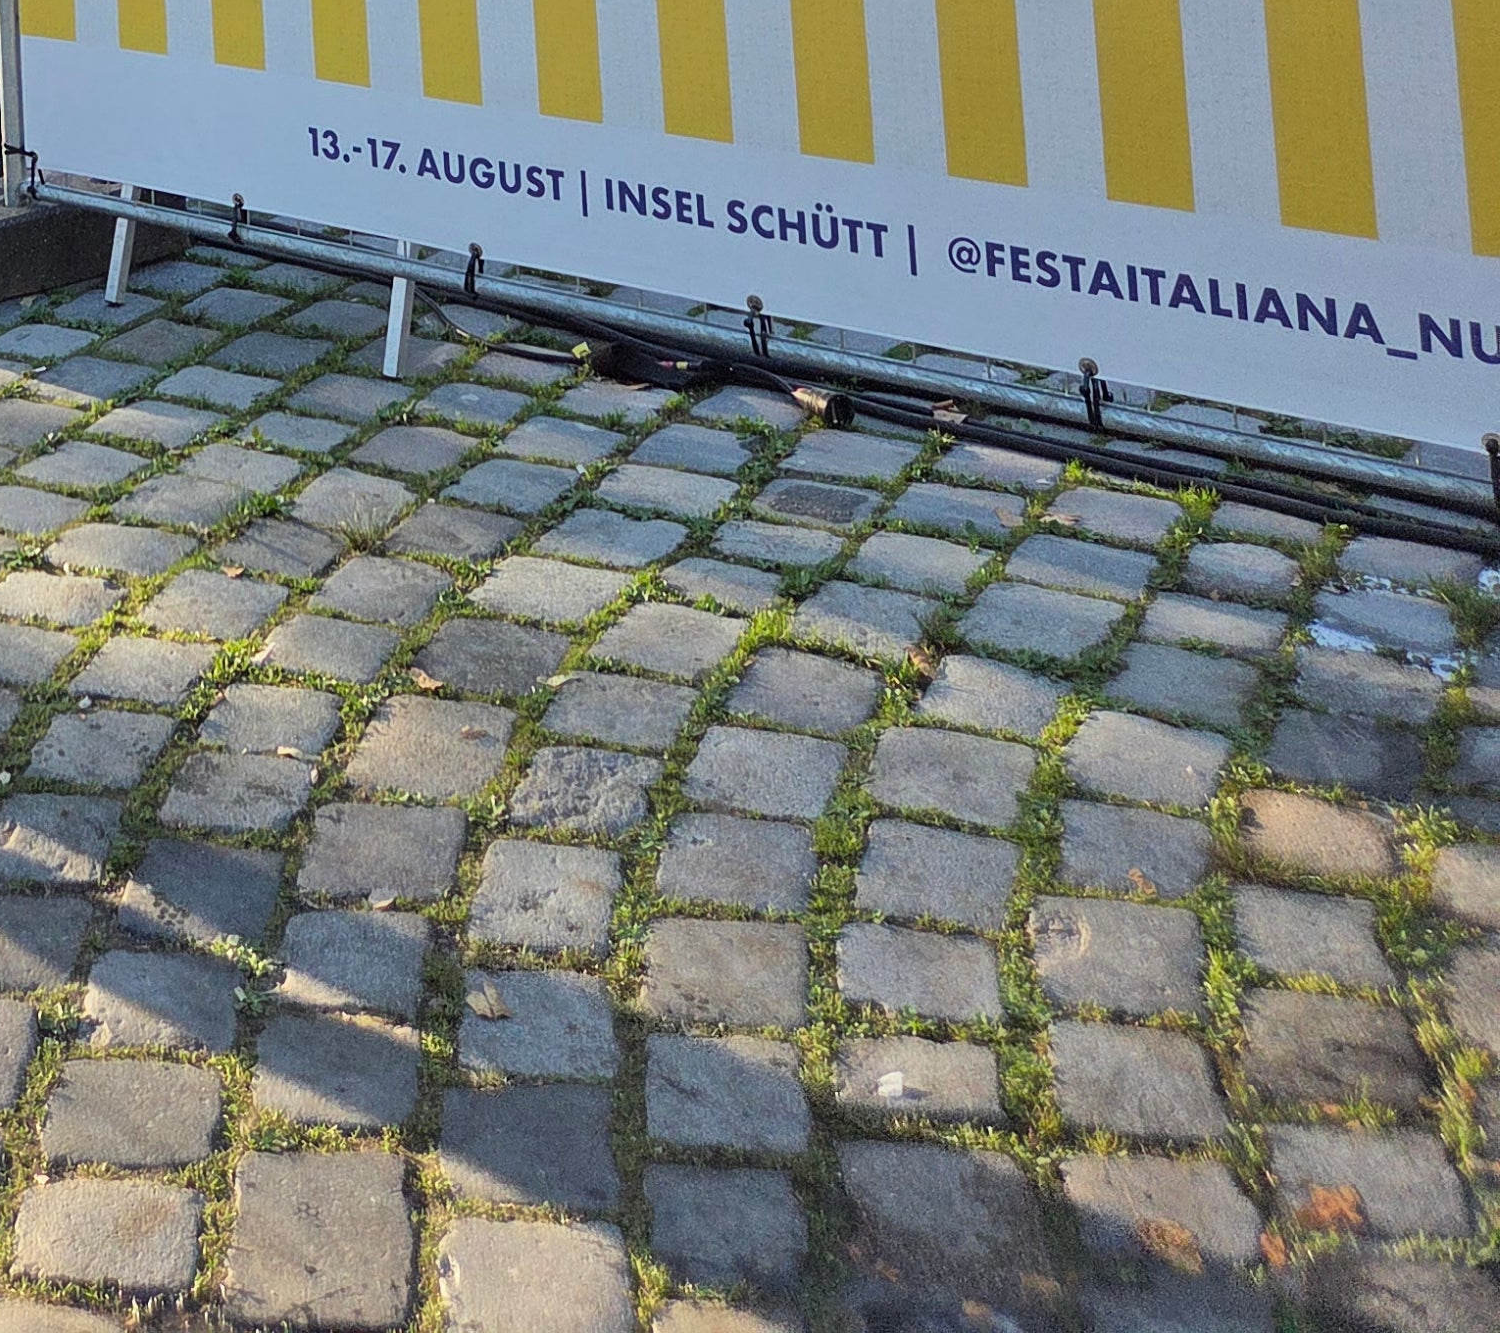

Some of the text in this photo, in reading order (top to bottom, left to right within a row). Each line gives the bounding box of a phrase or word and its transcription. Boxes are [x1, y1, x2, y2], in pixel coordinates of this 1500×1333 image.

[307, 126, 1500, 365] 13.-17. AUGUST INSEL SCHÜTT @FESTAITALIANA_NU
